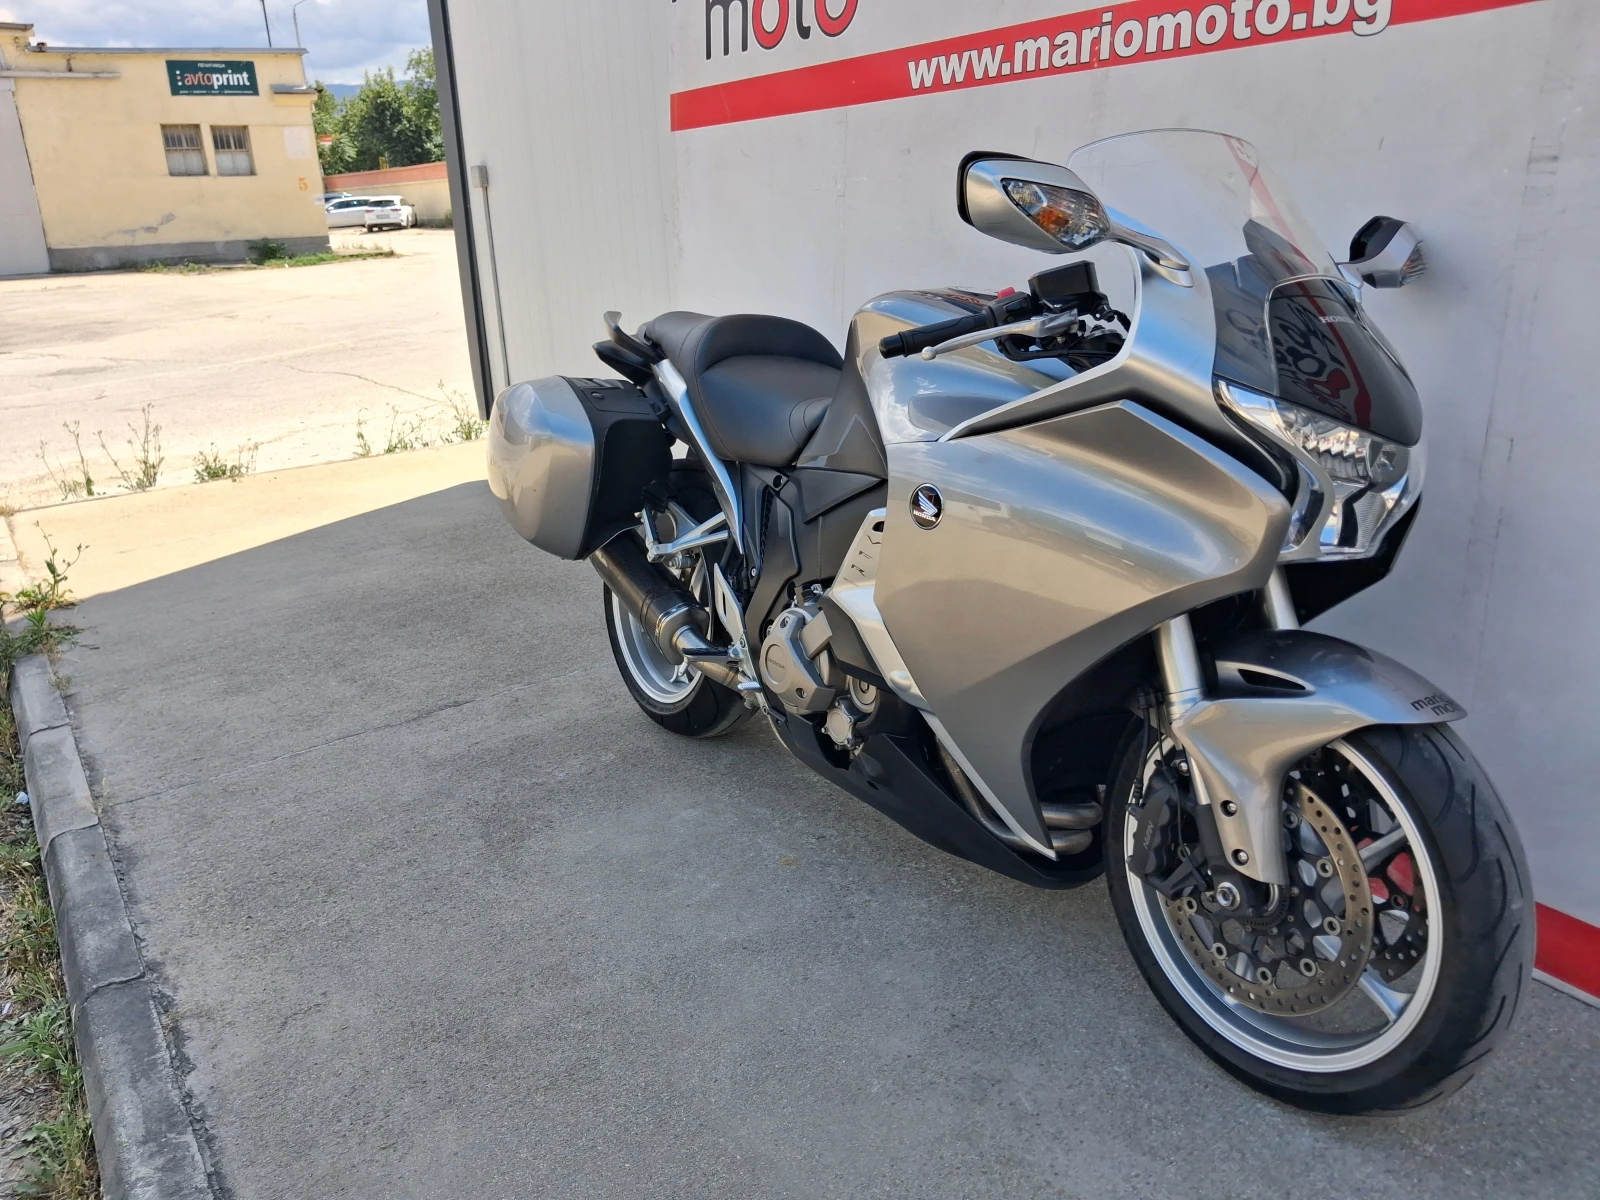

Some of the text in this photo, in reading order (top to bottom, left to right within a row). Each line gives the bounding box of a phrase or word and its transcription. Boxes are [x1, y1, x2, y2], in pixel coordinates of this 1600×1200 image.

[907, 0, 1391, 89] www.mariomoto.bg
[184, 69, 250, 90] avtoprint
[298, 176, 308, 192] 5
[913, 509, 937, 523] HONDA
